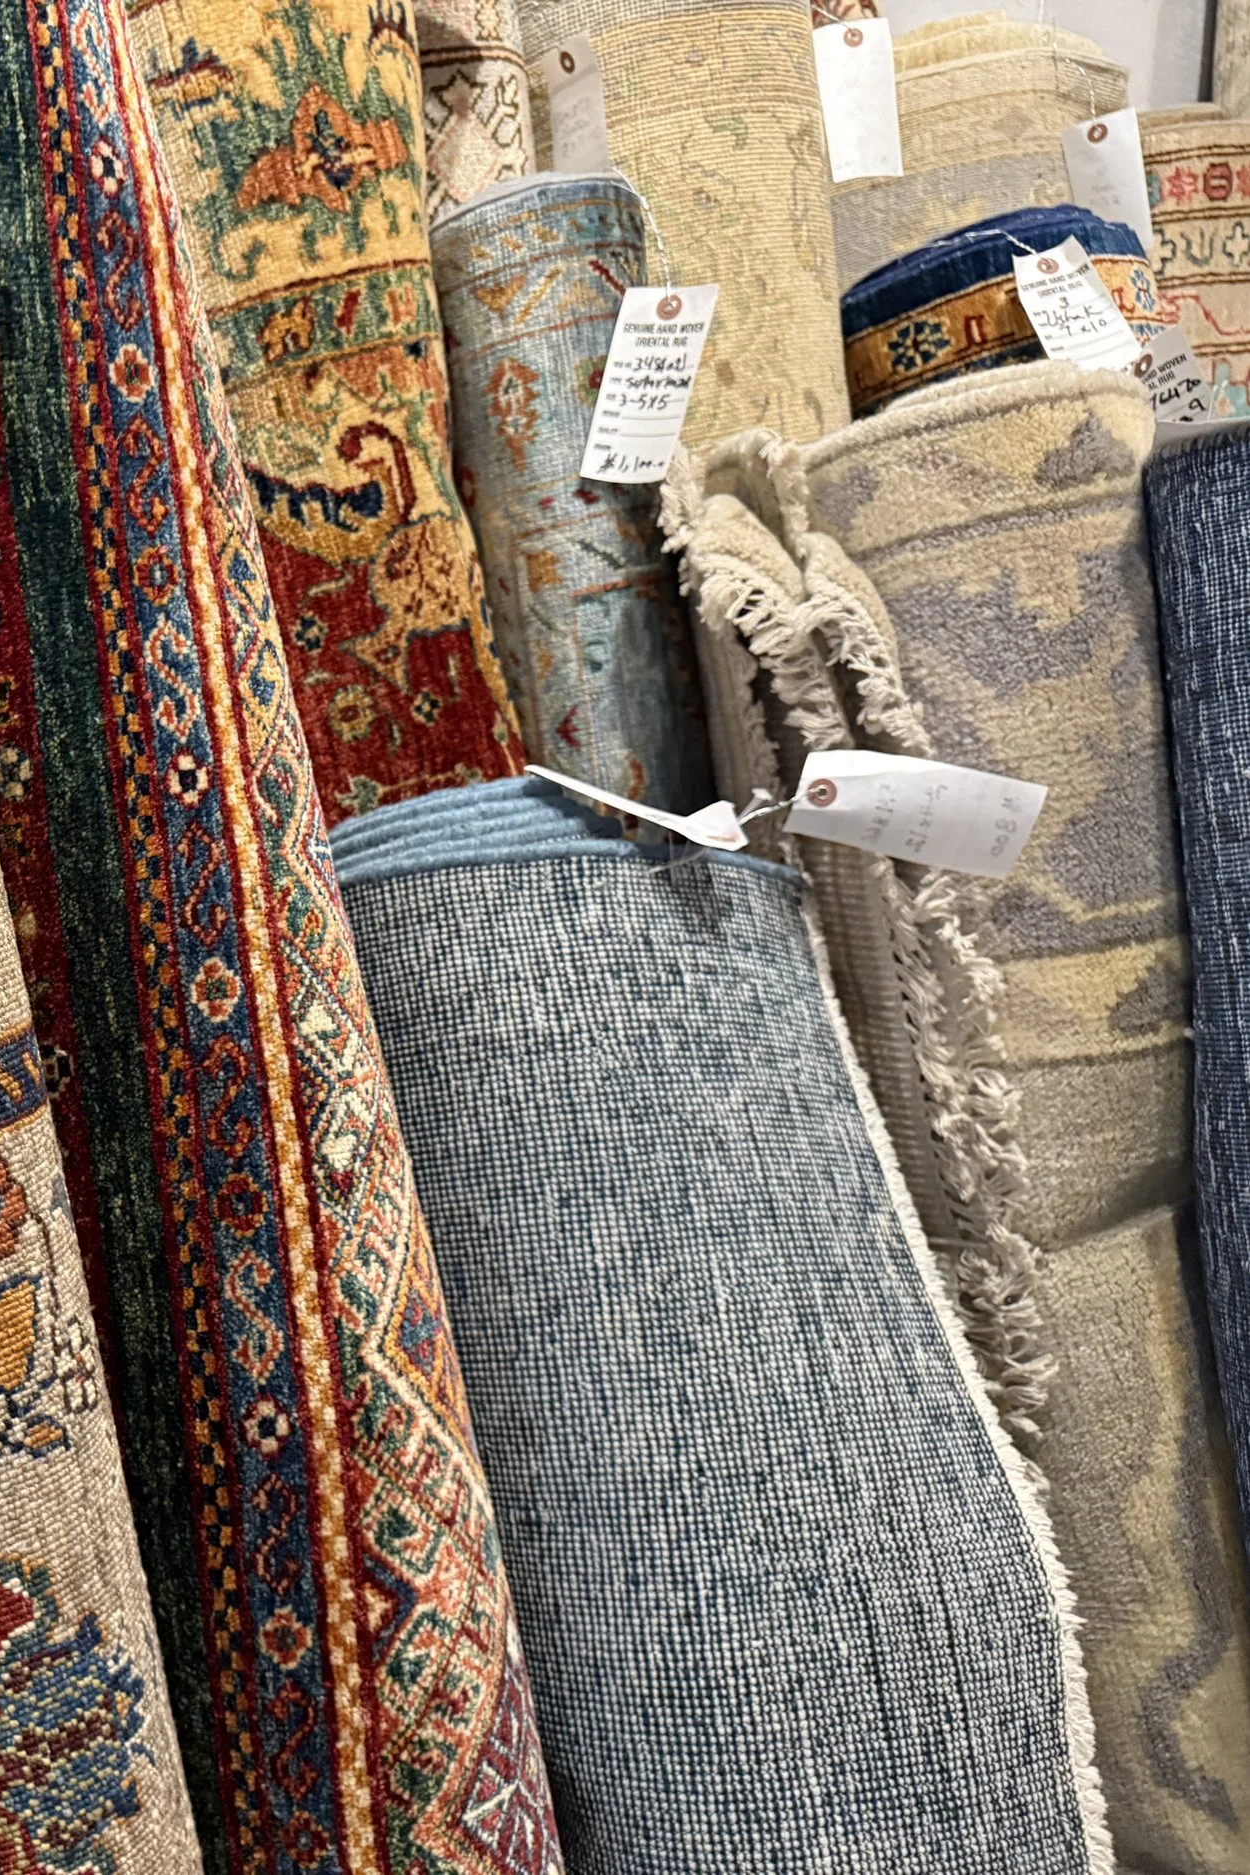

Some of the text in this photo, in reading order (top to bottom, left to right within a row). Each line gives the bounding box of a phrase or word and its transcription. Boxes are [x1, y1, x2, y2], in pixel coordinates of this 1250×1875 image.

[1049, 275, 1065, 284] HAND
[1067, 263, 1090, 278] WOVEN
[1068, 280, 1083, 290] RUG
[623, 322, 705, 334] GENUINE HAND WOVEN
[635, 336, 688, 347] ORIENTAL RUG
[1157, 353, 1188, 374] WOVEN
[1158, 370, 1176, 386] RUG
